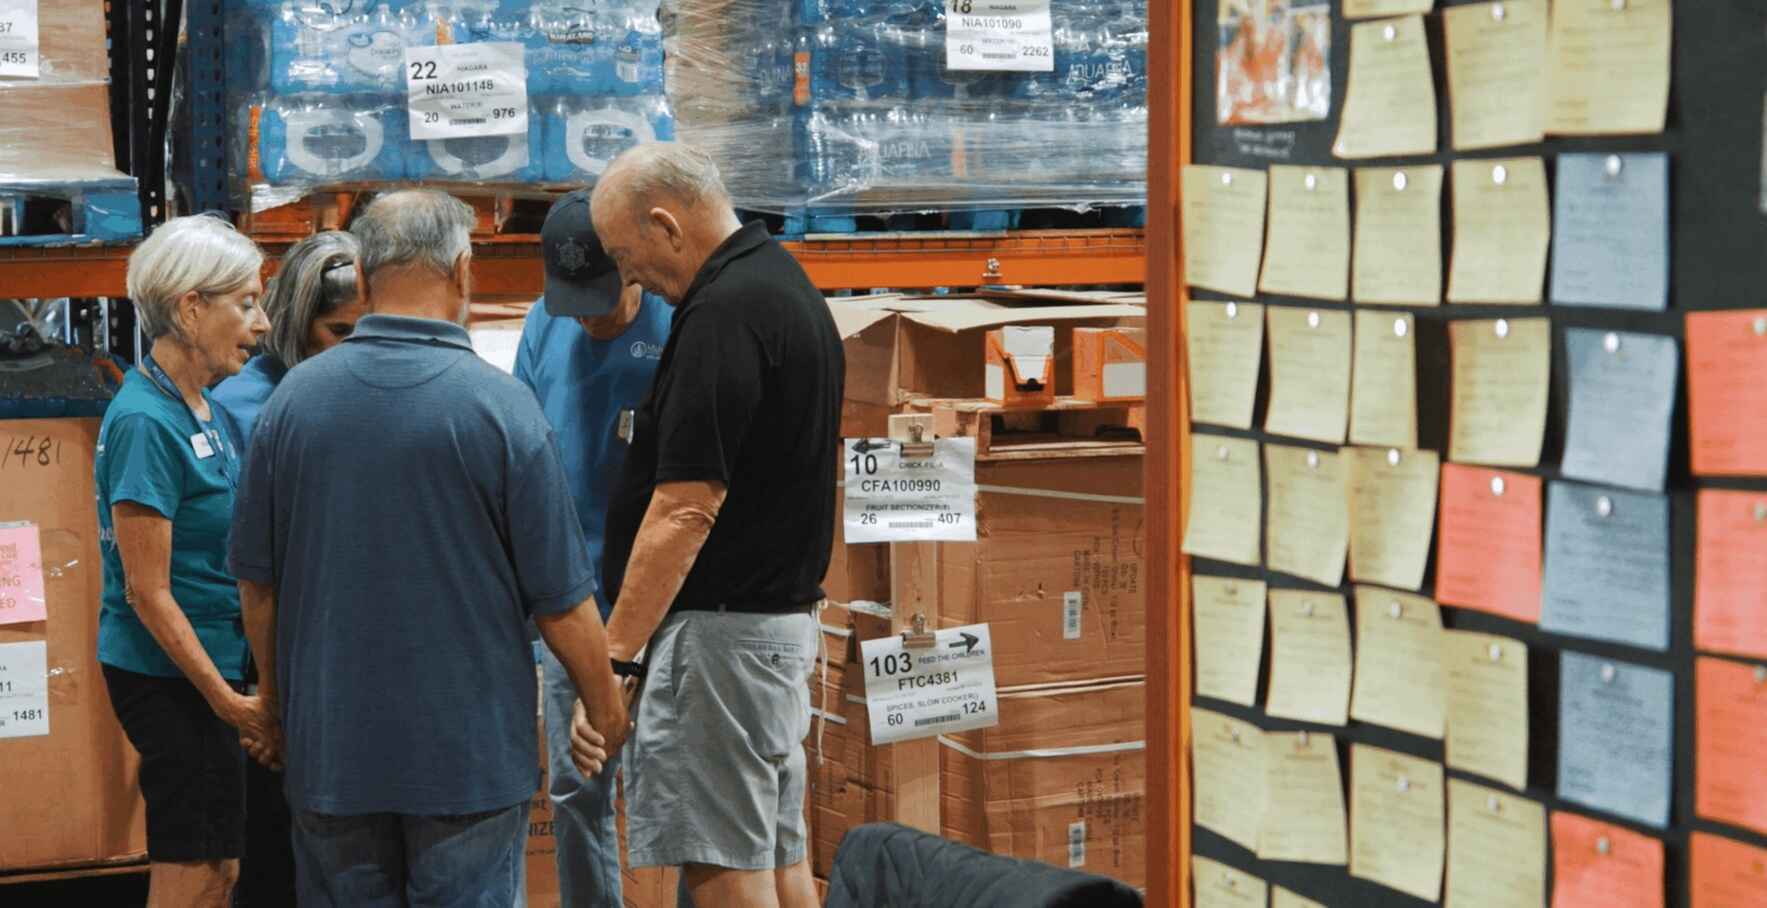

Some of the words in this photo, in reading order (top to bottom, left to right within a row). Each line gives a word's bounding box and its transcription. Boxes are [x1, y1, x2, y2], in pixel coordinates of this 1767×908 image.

[952, 0, 972, 14] 18
[961, 18, 1022, 29] NIA101090
[1023, 46, 1049, 57] 2262
[410, 60, 438, 80] 22
[426, 80, 494, 95] NIA101148
[424, 112, 439, 123] 20
[492, 107, 516, 119] 976
[850, 454, 878, 475] 10
[861, 479, 941, 493] CFA100990
[860, 512, 877, 525] 26
[937, 512, 961, 524] 407
[870, 652, 912, 677] 103
[898, 671, 959, 690] FTC4381
[14, 709, 43, 721] 1481
[887, 712, 904, 726] 60
[962, 700, 986, 714] 124
